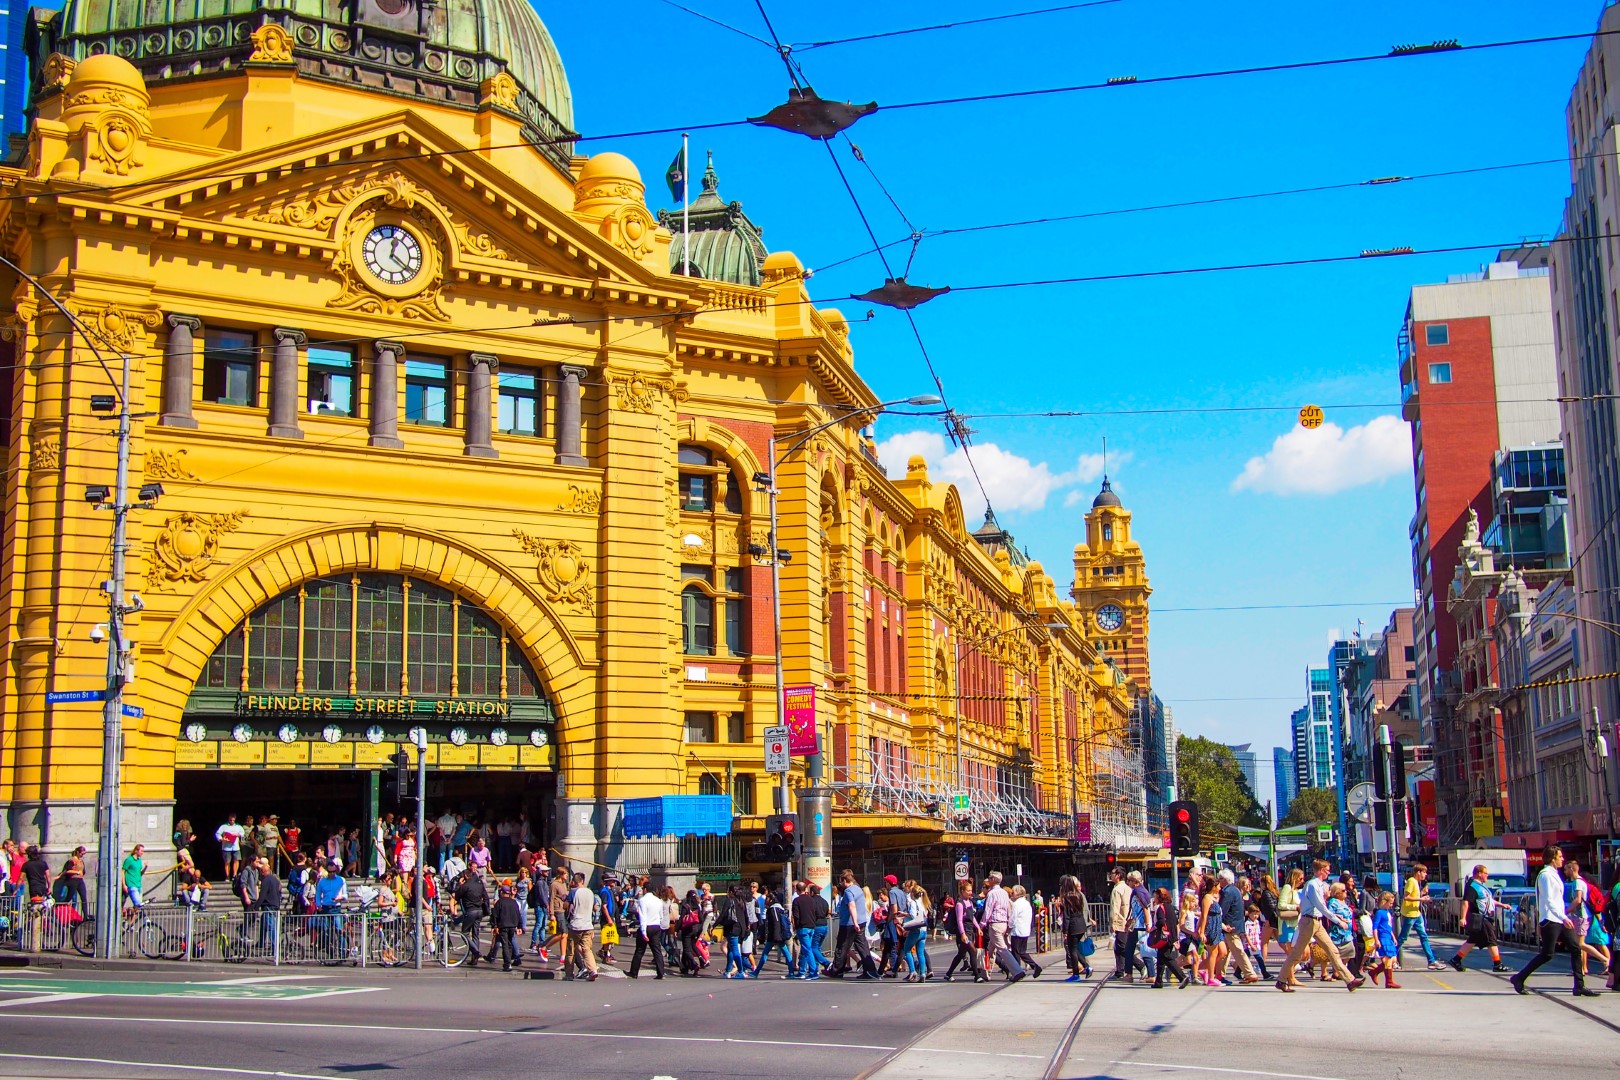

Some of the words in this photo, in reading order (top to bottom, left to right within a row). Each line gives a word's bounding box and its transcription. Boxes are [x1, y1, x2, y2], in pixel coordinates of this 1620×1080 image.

[1300, 408, 1320, 417] CUT
[1301, 418, 1321, 427] OFF
[48, 692, 81, 700] Swanston
[787, 695, 812, 703] COMEDY
[247, 695, 333, 711] FLINDERS
[354, 698, 417, 713] STREET
[435, 700, 508, 715] STATION
[787, 702, 812, 710] FESTIVAL
[773, 743, 780, 753] C
